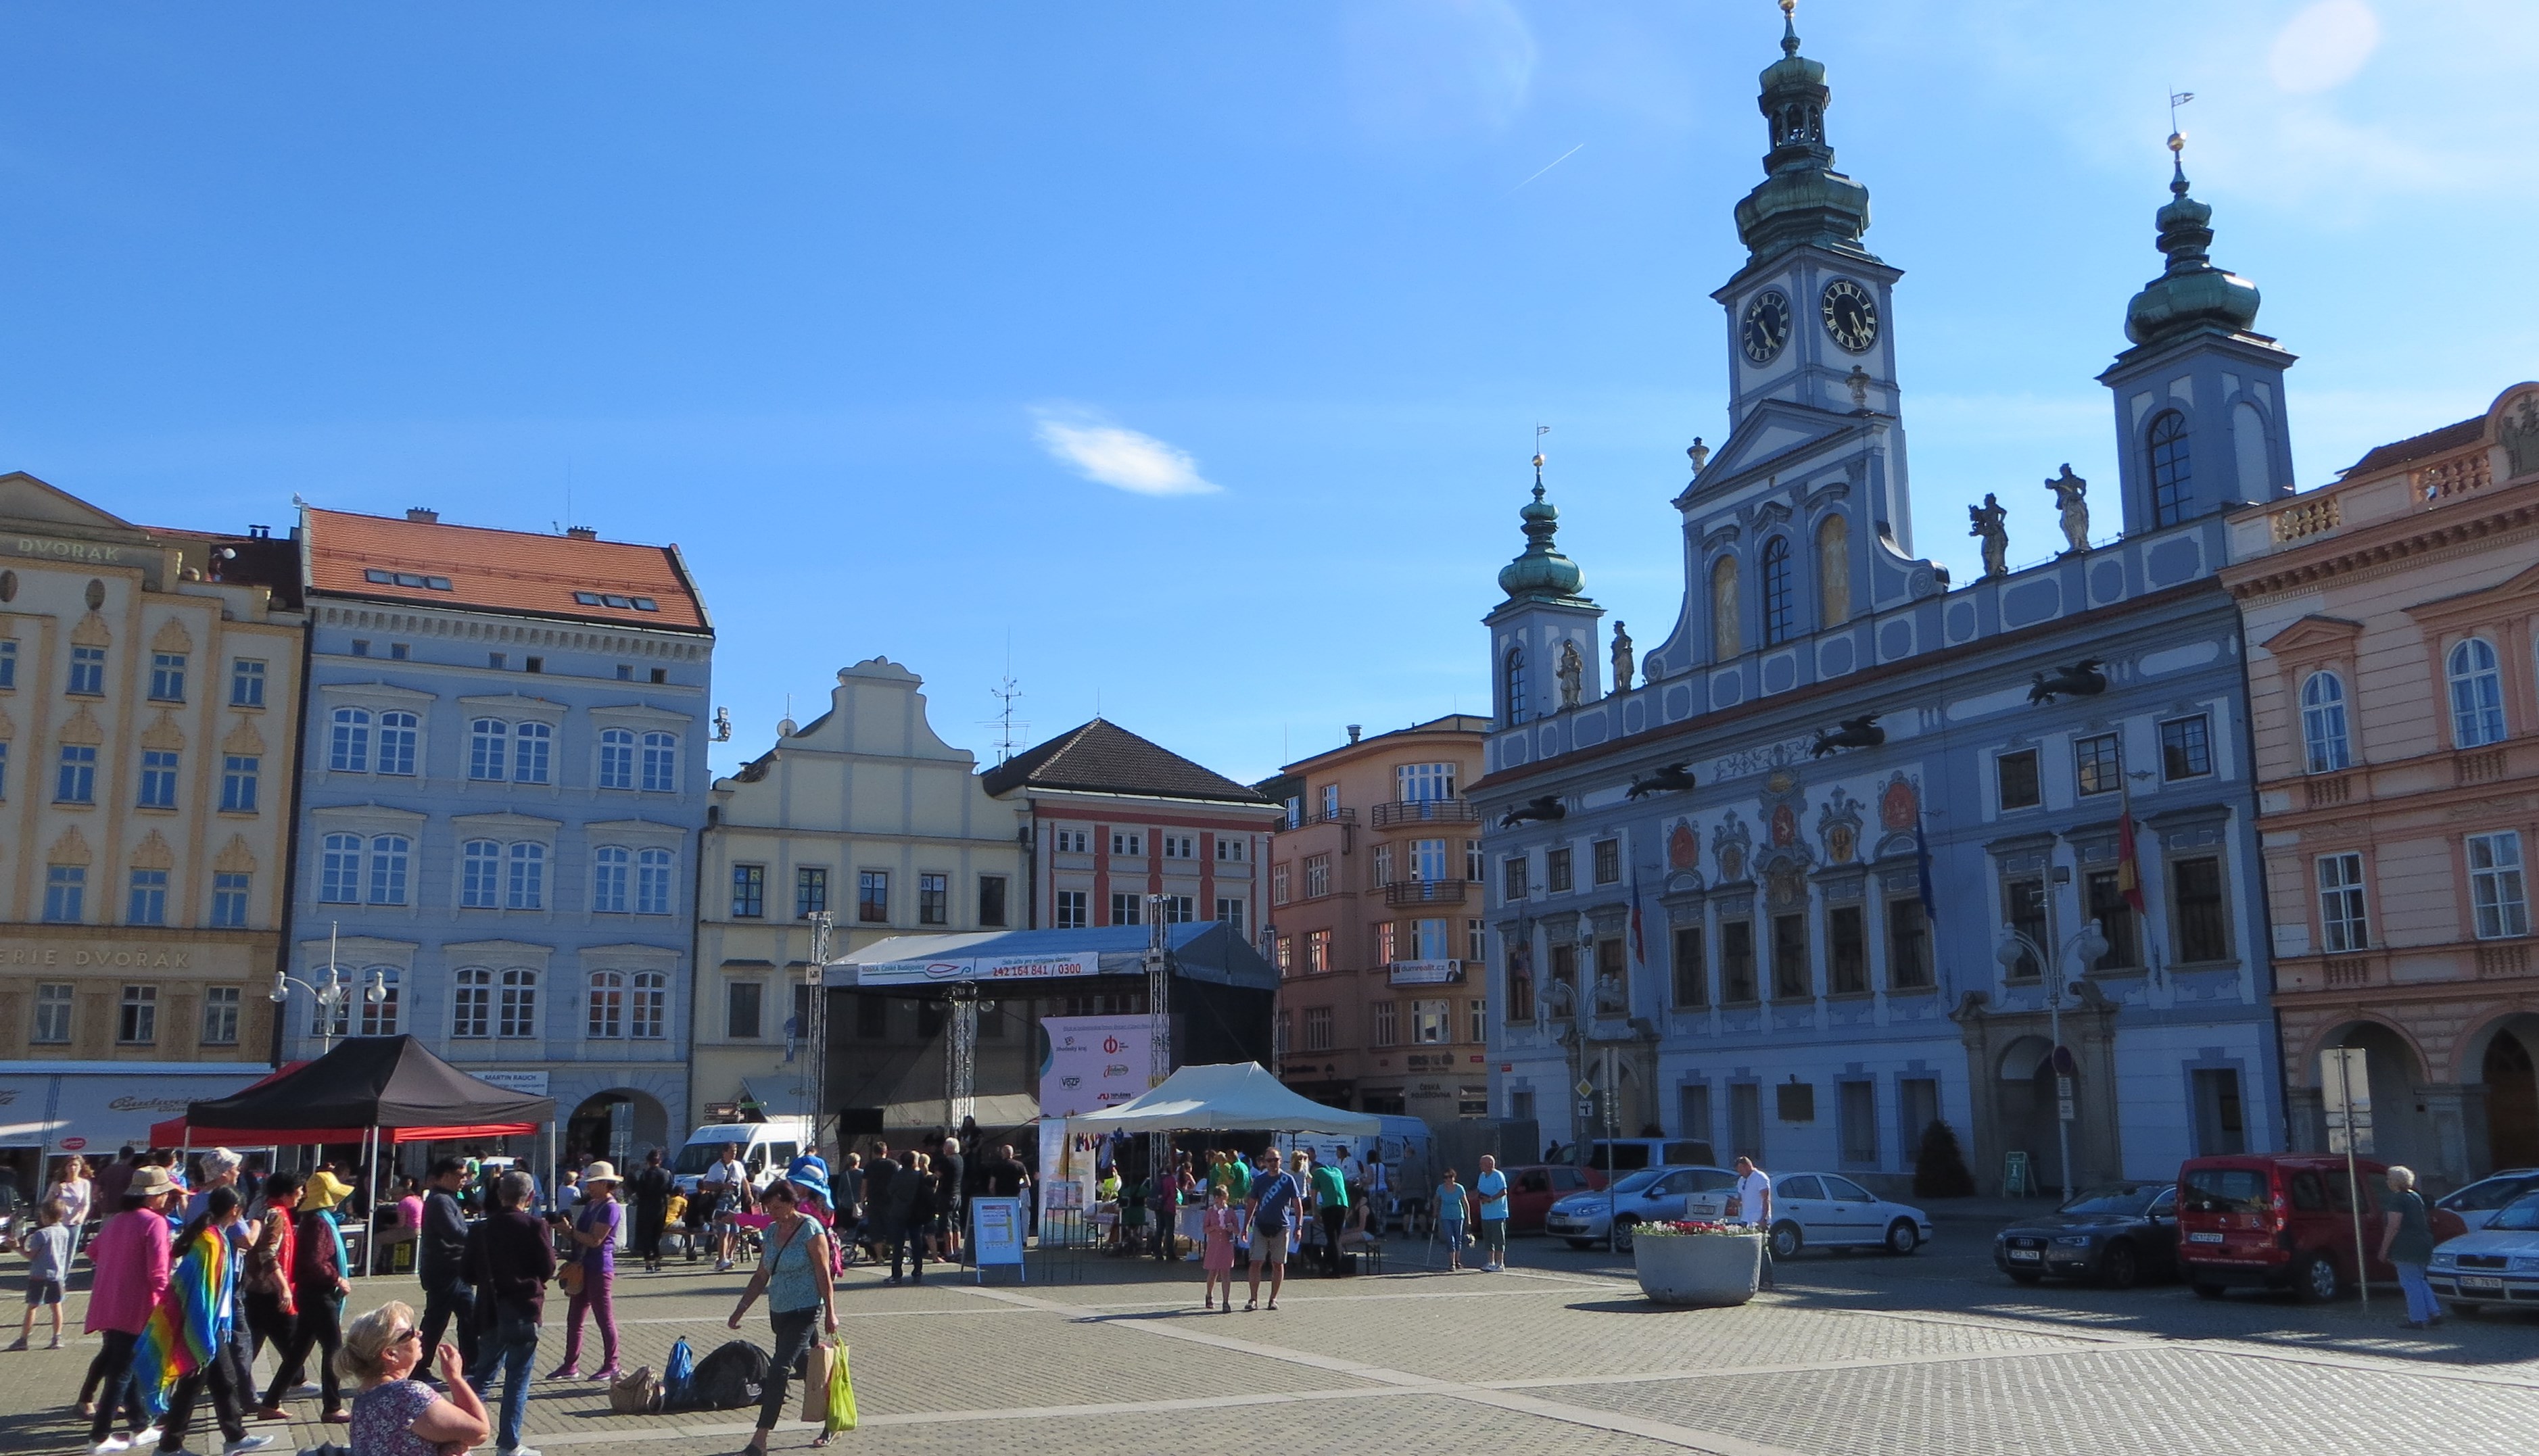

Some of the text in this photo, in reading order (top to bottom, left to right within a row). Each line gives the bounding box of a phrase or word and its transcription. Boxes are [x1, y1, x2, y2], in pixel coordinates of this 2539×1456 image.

[75, 948, 188, 968] DVOŘÁK
[993, 967, 1010, 976] 242
[1013, 966, 1028, 976] 164
[1031, 965, 1047, 975] 841
[1058, 963, 1081, 973] 0300
